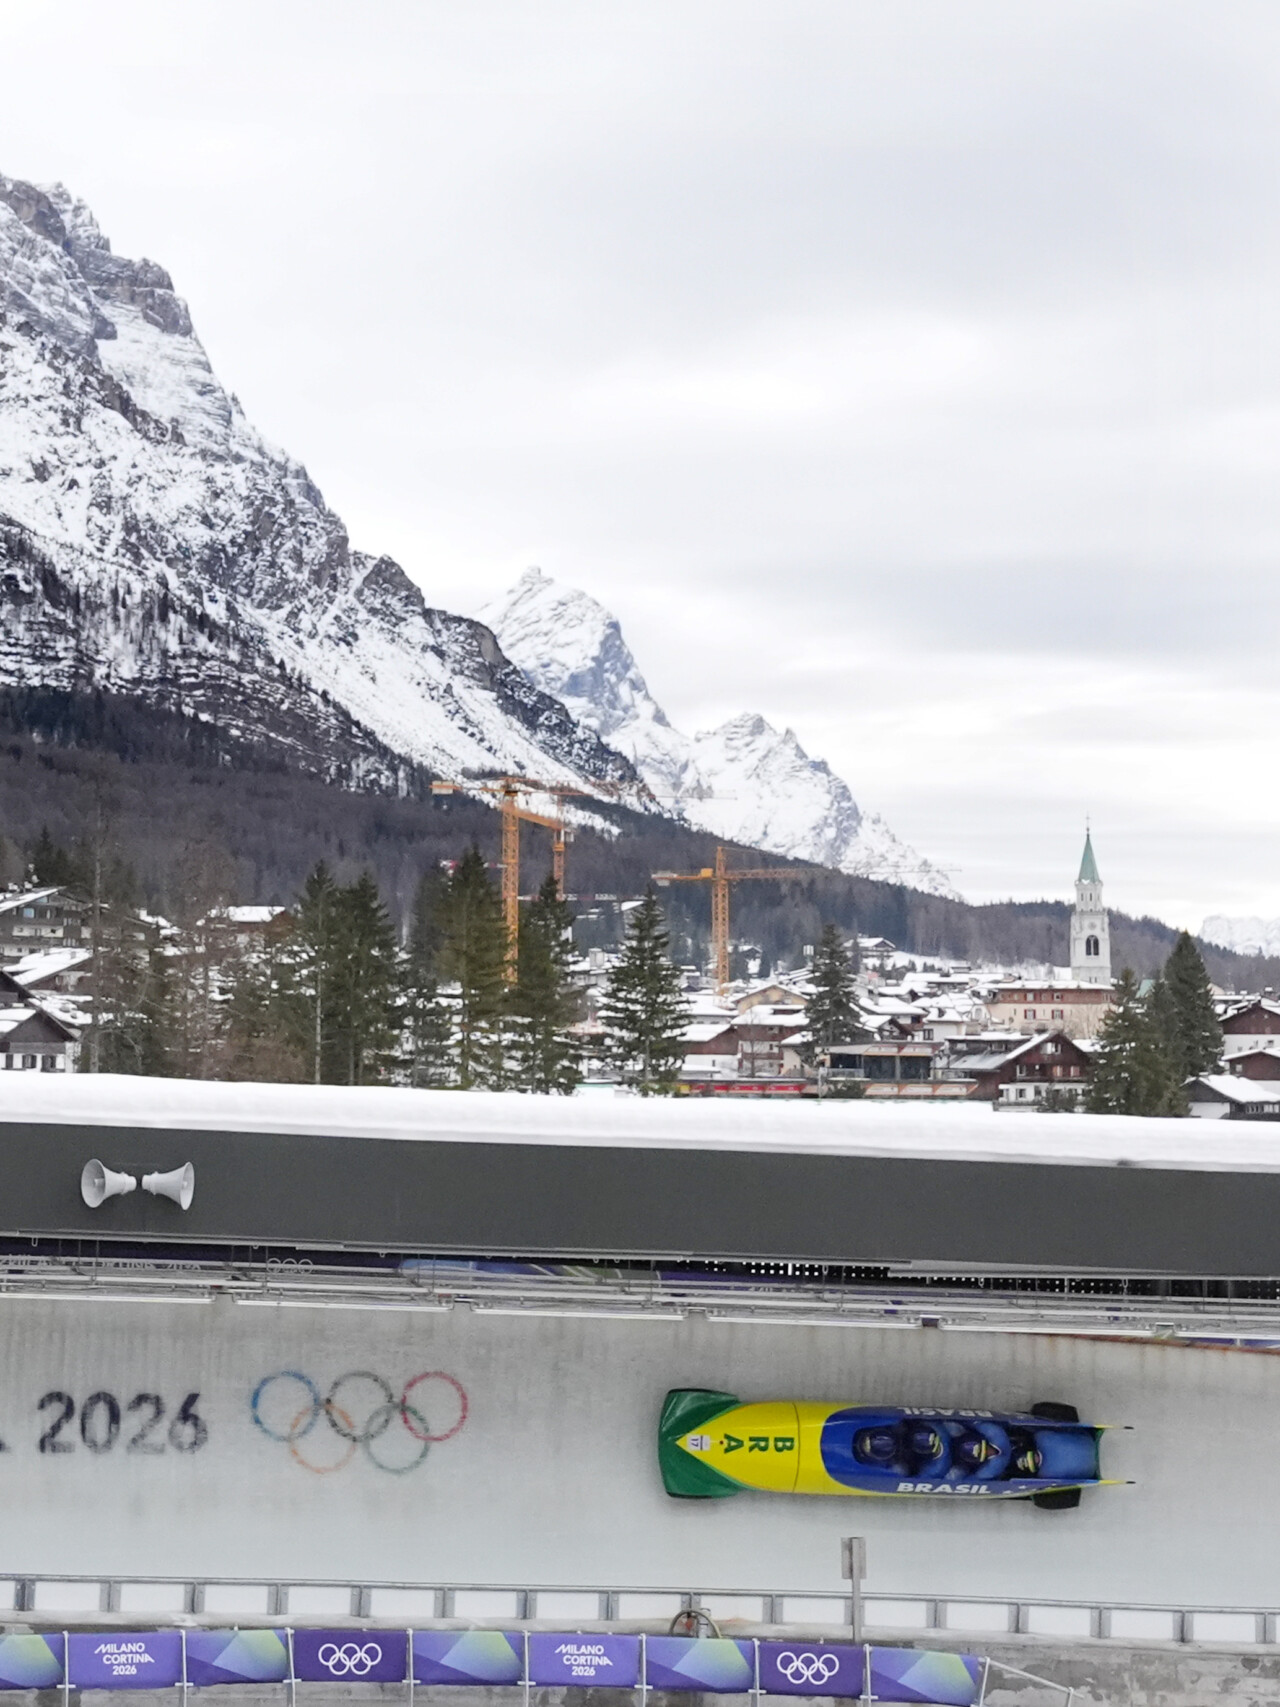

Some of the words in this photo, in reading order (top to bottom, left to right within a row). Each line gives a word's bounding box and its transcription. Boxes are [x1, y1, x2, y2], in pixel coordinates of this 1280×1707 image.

[36, 1390, 210, 1455] 2026
[723, 1433, 795, 1454] BRA
[896, 1482, 991, 1495] BRASIL
[94, 1642, 145, 1654] MILANO
[554, 1643, 604, 1655] MILANO
[102, 1653, 155, 1664] CORTINA
[562, 1654, 613, 1666] CORTINA
[112, 1665, 137, 1675] 2026
[571, 1666, 596, 1676] 2026
